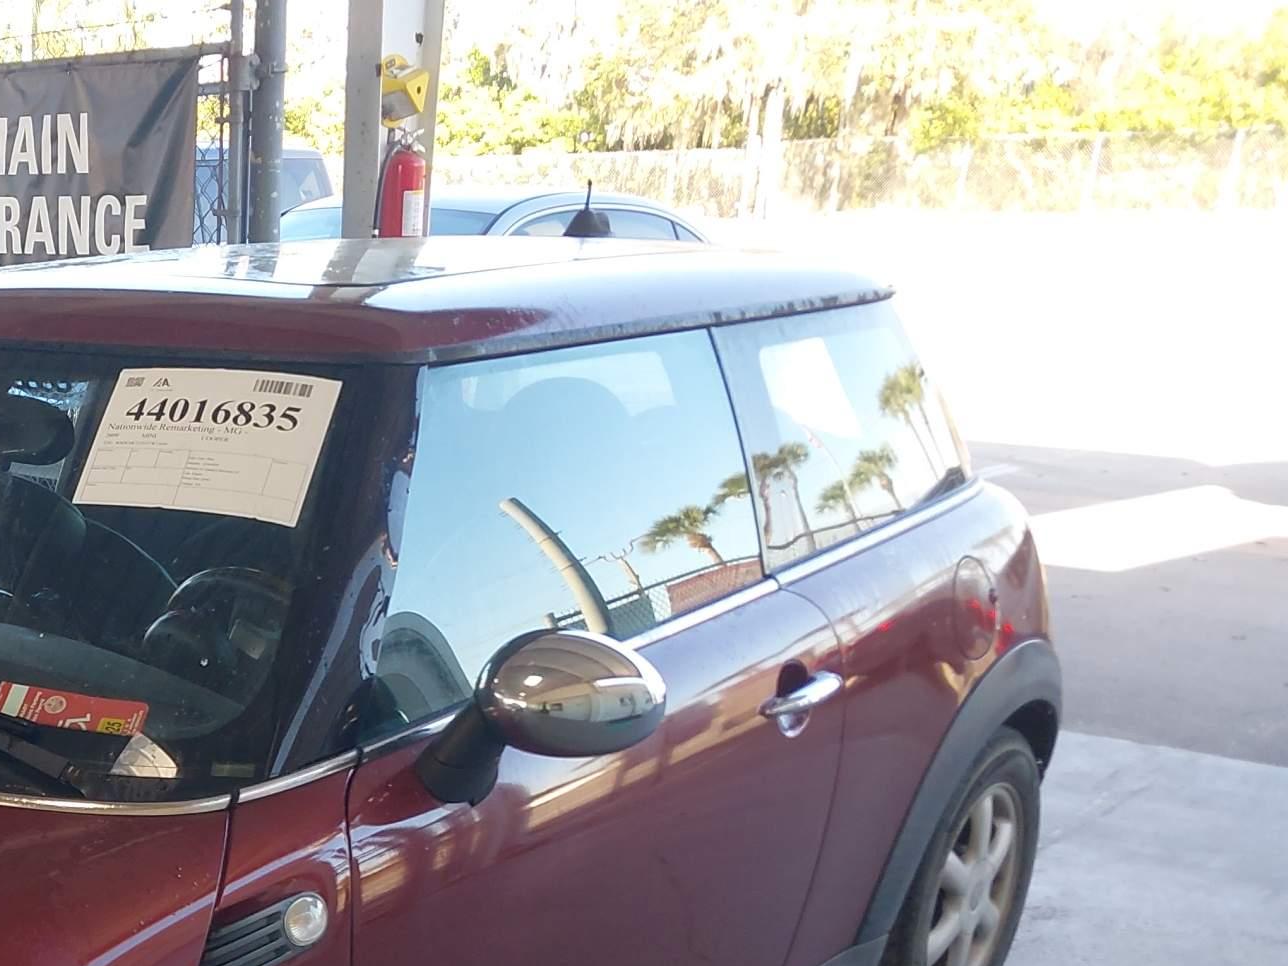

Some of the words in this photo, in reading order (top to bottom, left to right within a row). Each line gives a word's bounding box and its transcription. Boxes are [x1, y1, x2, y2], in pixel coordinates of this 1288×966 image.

[126, 397, 302, 431] 44016835
[108, 423, 157, 431] Nationwide
[159, 424, 215, 434] Remarketing
